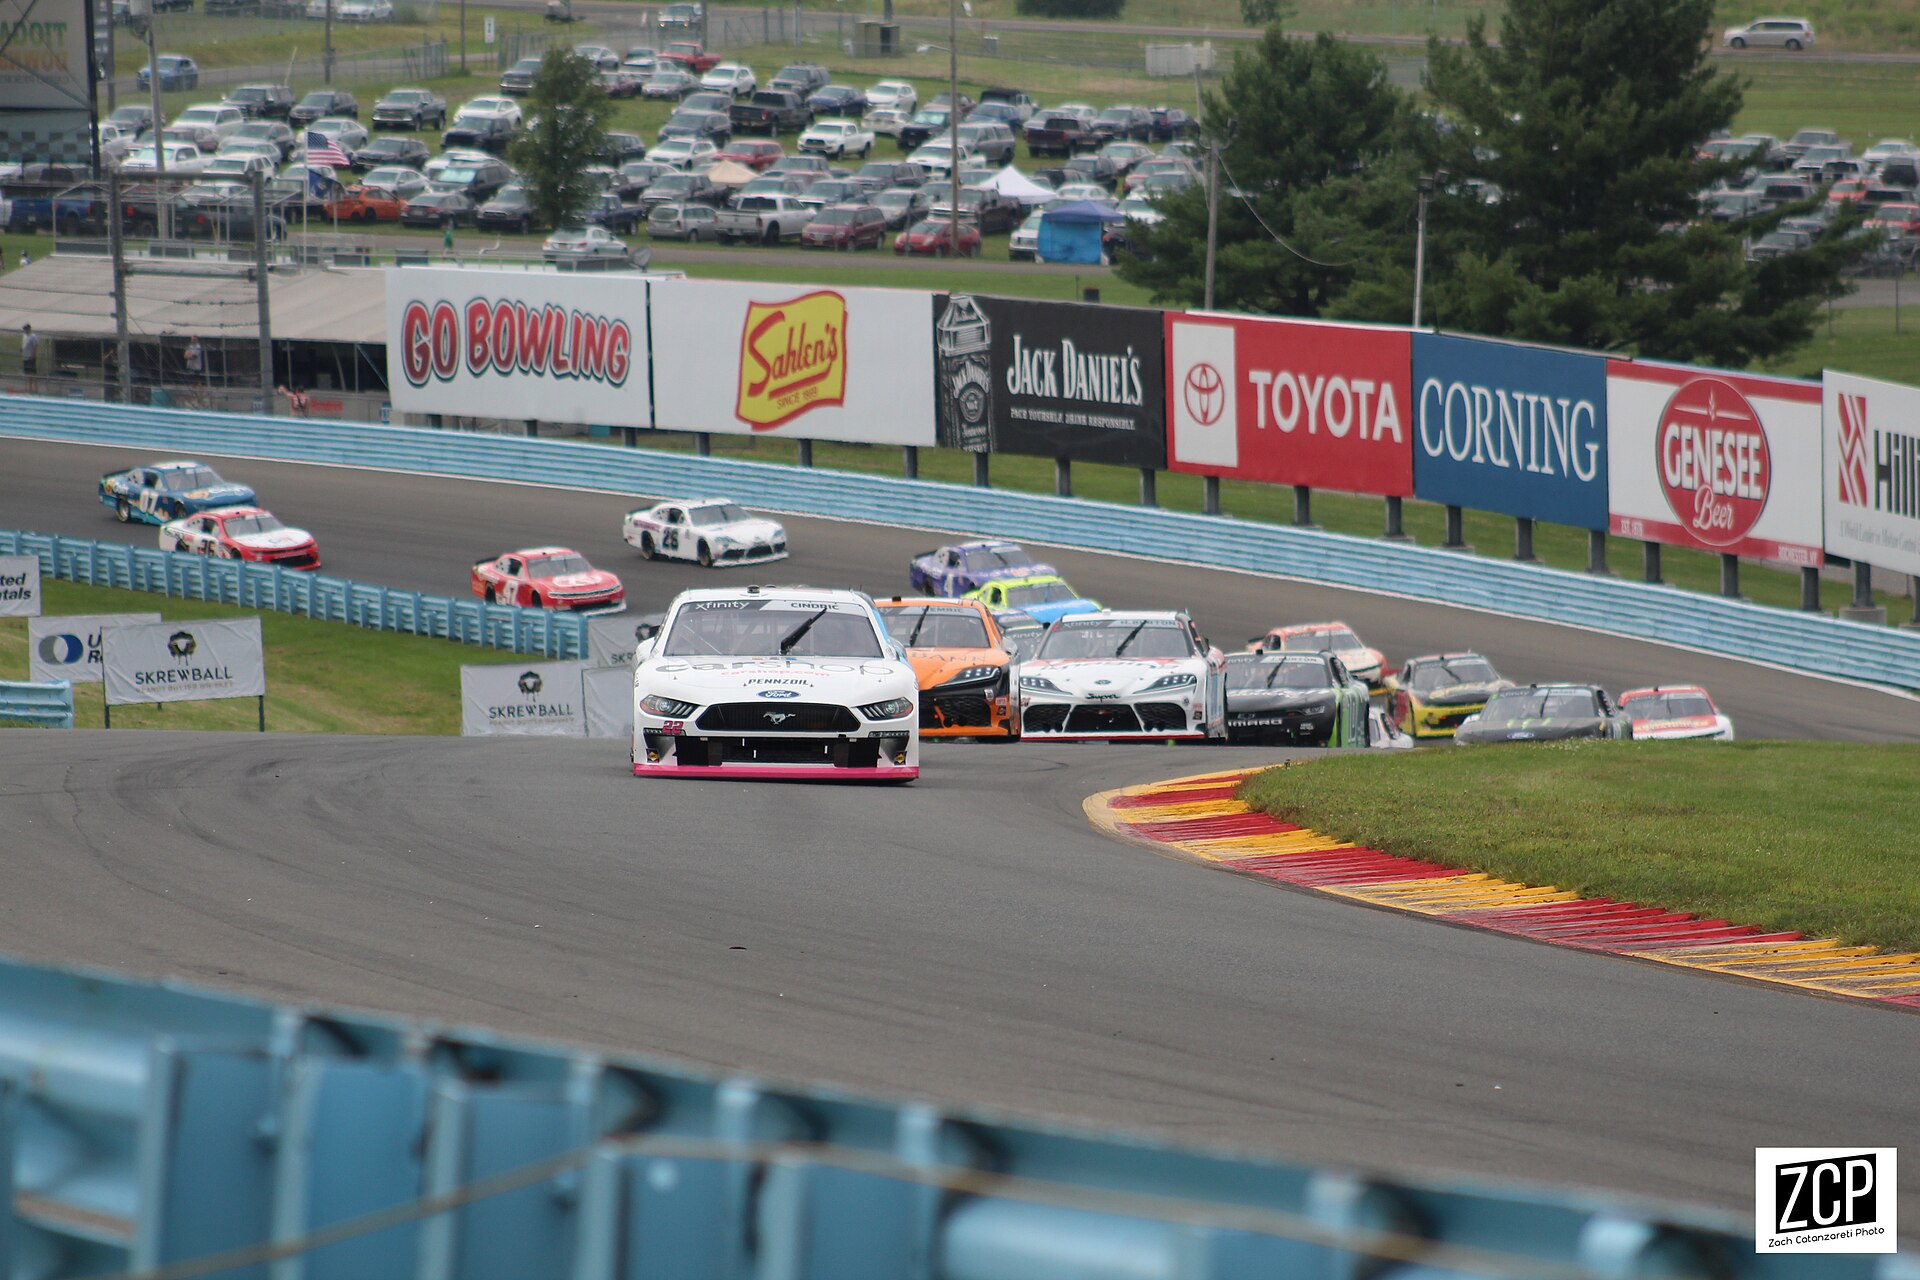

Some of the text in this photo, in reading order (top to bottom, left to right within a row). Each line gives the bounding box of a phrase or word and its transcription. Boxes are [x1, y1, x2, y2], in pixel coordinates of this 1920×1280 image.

[401, 297, 631, 387] GO BOWLING
[747, 310, 838, 398] Sahlen's
[1006, 334, 1143, 406] JACK DANIEL'S
[1249, 370, 1402, 443] TOYOTA
[1419, 378, 1599, 482] CORNING
[1663, 422, 1763, 500] GENESEE
[1692, 484, 1735, 531] Beer
[696, 601, 749, 611] xfinity
[791, 602, 839, 611] CINDRIC
[135, 666, 233, 685] SKREWBALL
[656, 660, 894, 676] carshop
[748, 678, 809, 686] PENNZOIL
[765, 690, 793, 699] Ford
[489, 704, 573, 719] SKREWBALL
[662, 720, 685, 735] 22
